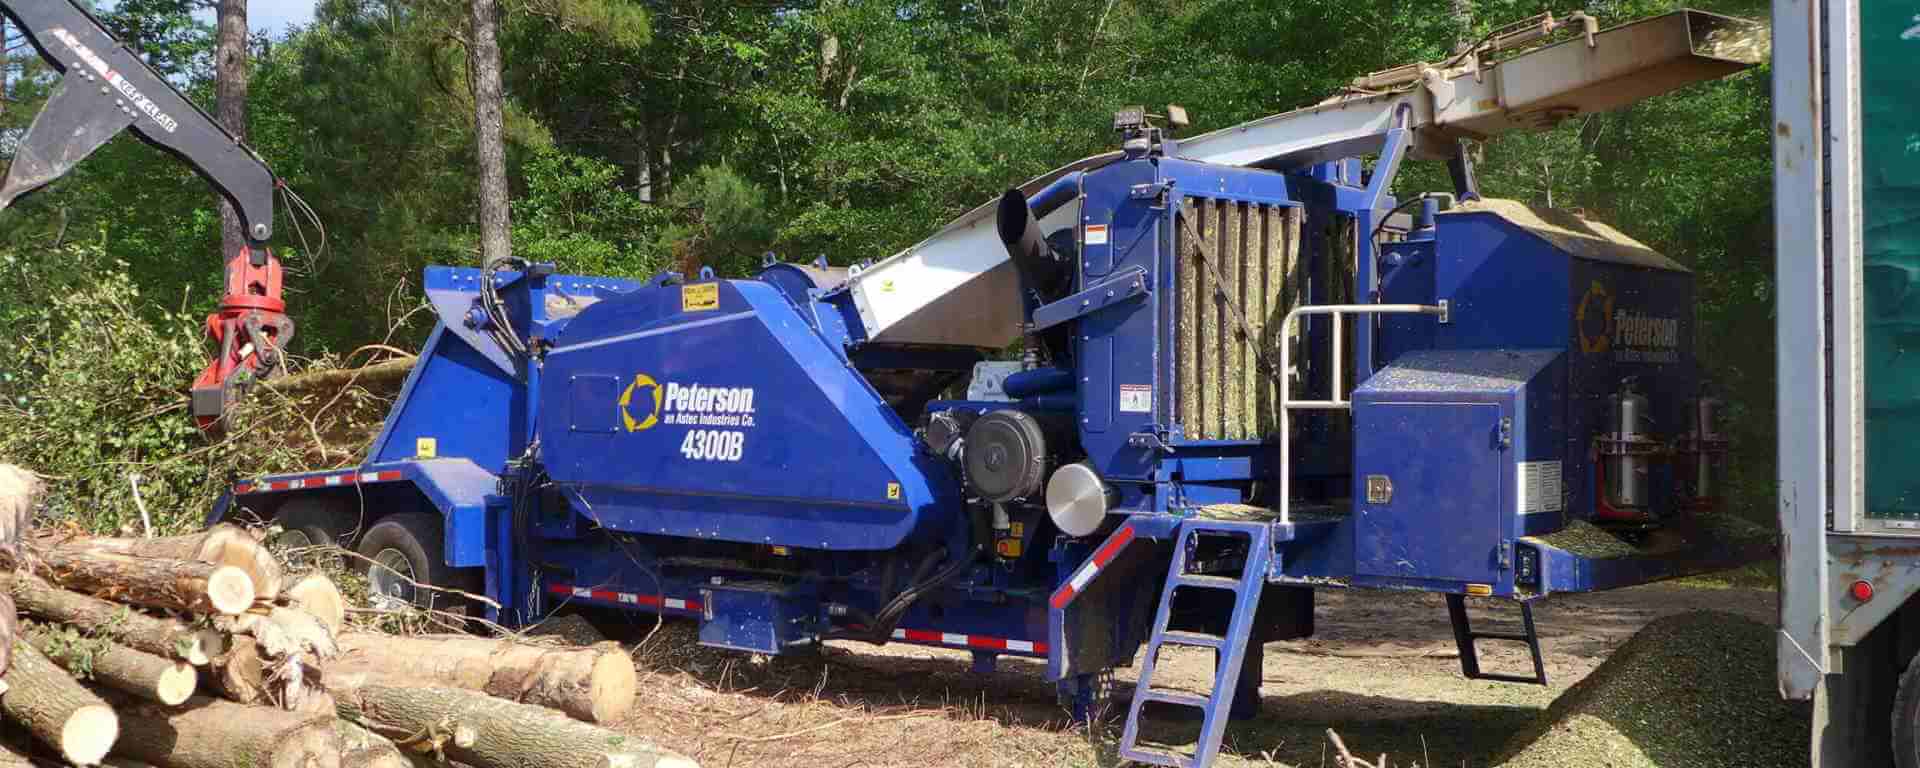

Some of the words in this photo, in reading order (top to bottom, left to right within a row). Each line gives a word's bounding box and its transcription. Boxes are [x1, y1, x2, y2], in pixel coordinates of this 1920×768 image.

[664, 414, 675, 425] an
[699, 413, 740, 426] Industries
[741, 414, 755, 427] Co.
[681, 429, 744, 461] 4300B
